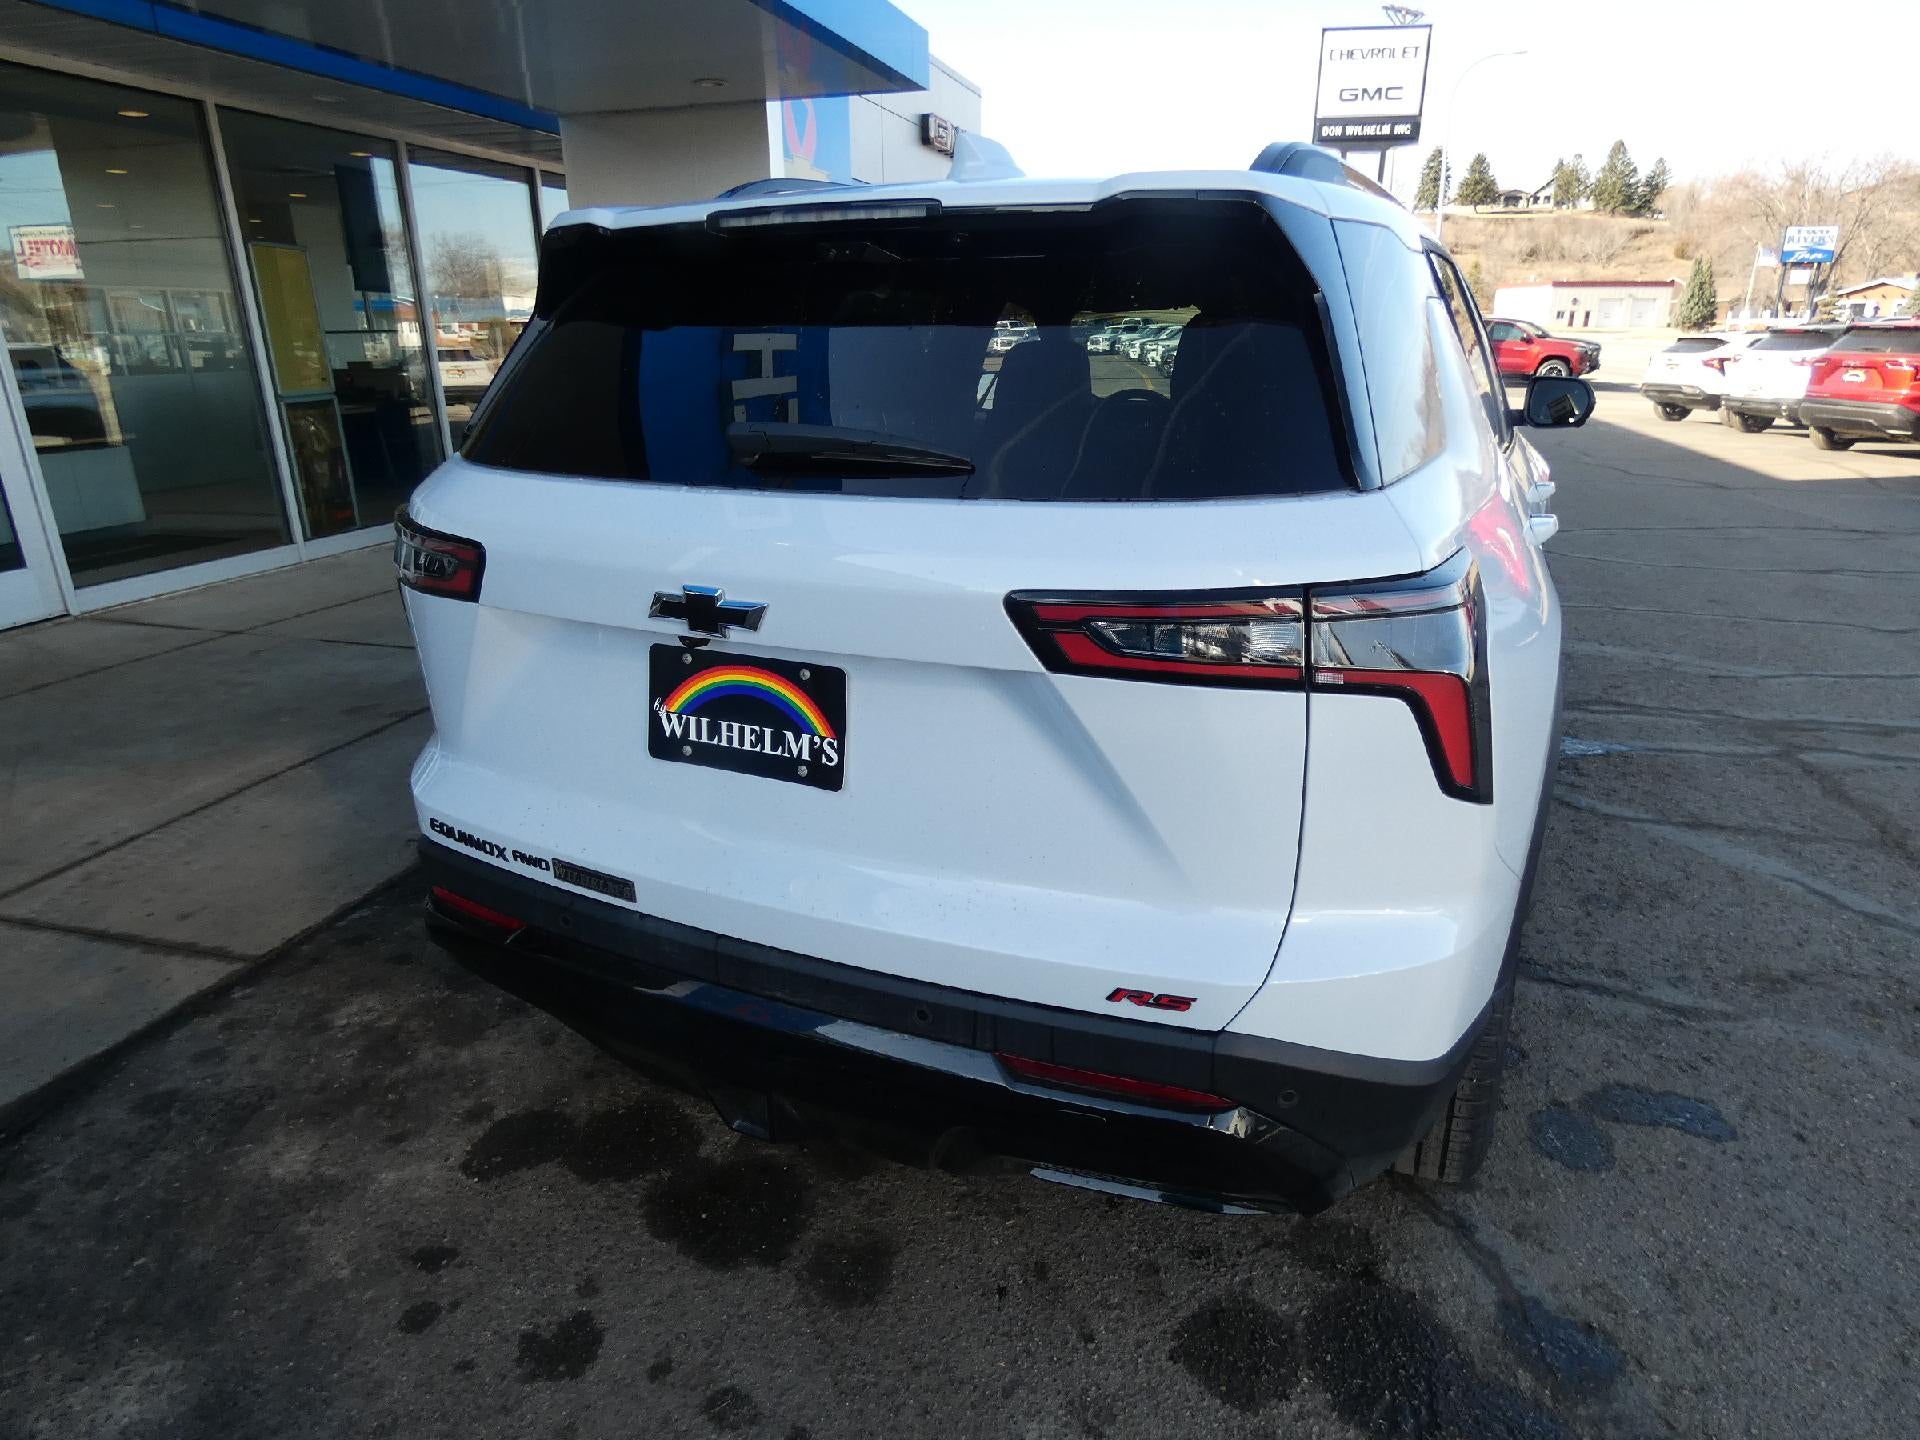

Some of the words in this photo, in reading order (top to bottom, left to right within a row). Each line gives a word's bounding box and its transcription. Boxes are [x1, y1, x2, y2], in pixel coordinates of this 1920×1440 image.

[1328, 46, 1420, 61] CHEVROLET
[1338, 86, 1404, 102] GMC
[1321, 125, 1343, 136] DON
[1345, 124, 1392, 136] WILHELM
[659, 711, 839, 767] WILHELM'S
[429, 817, 510, 863] EQUINOX
[511, 850, 551, 872] AWD
[1105, 987, 1198, 1012] RS
